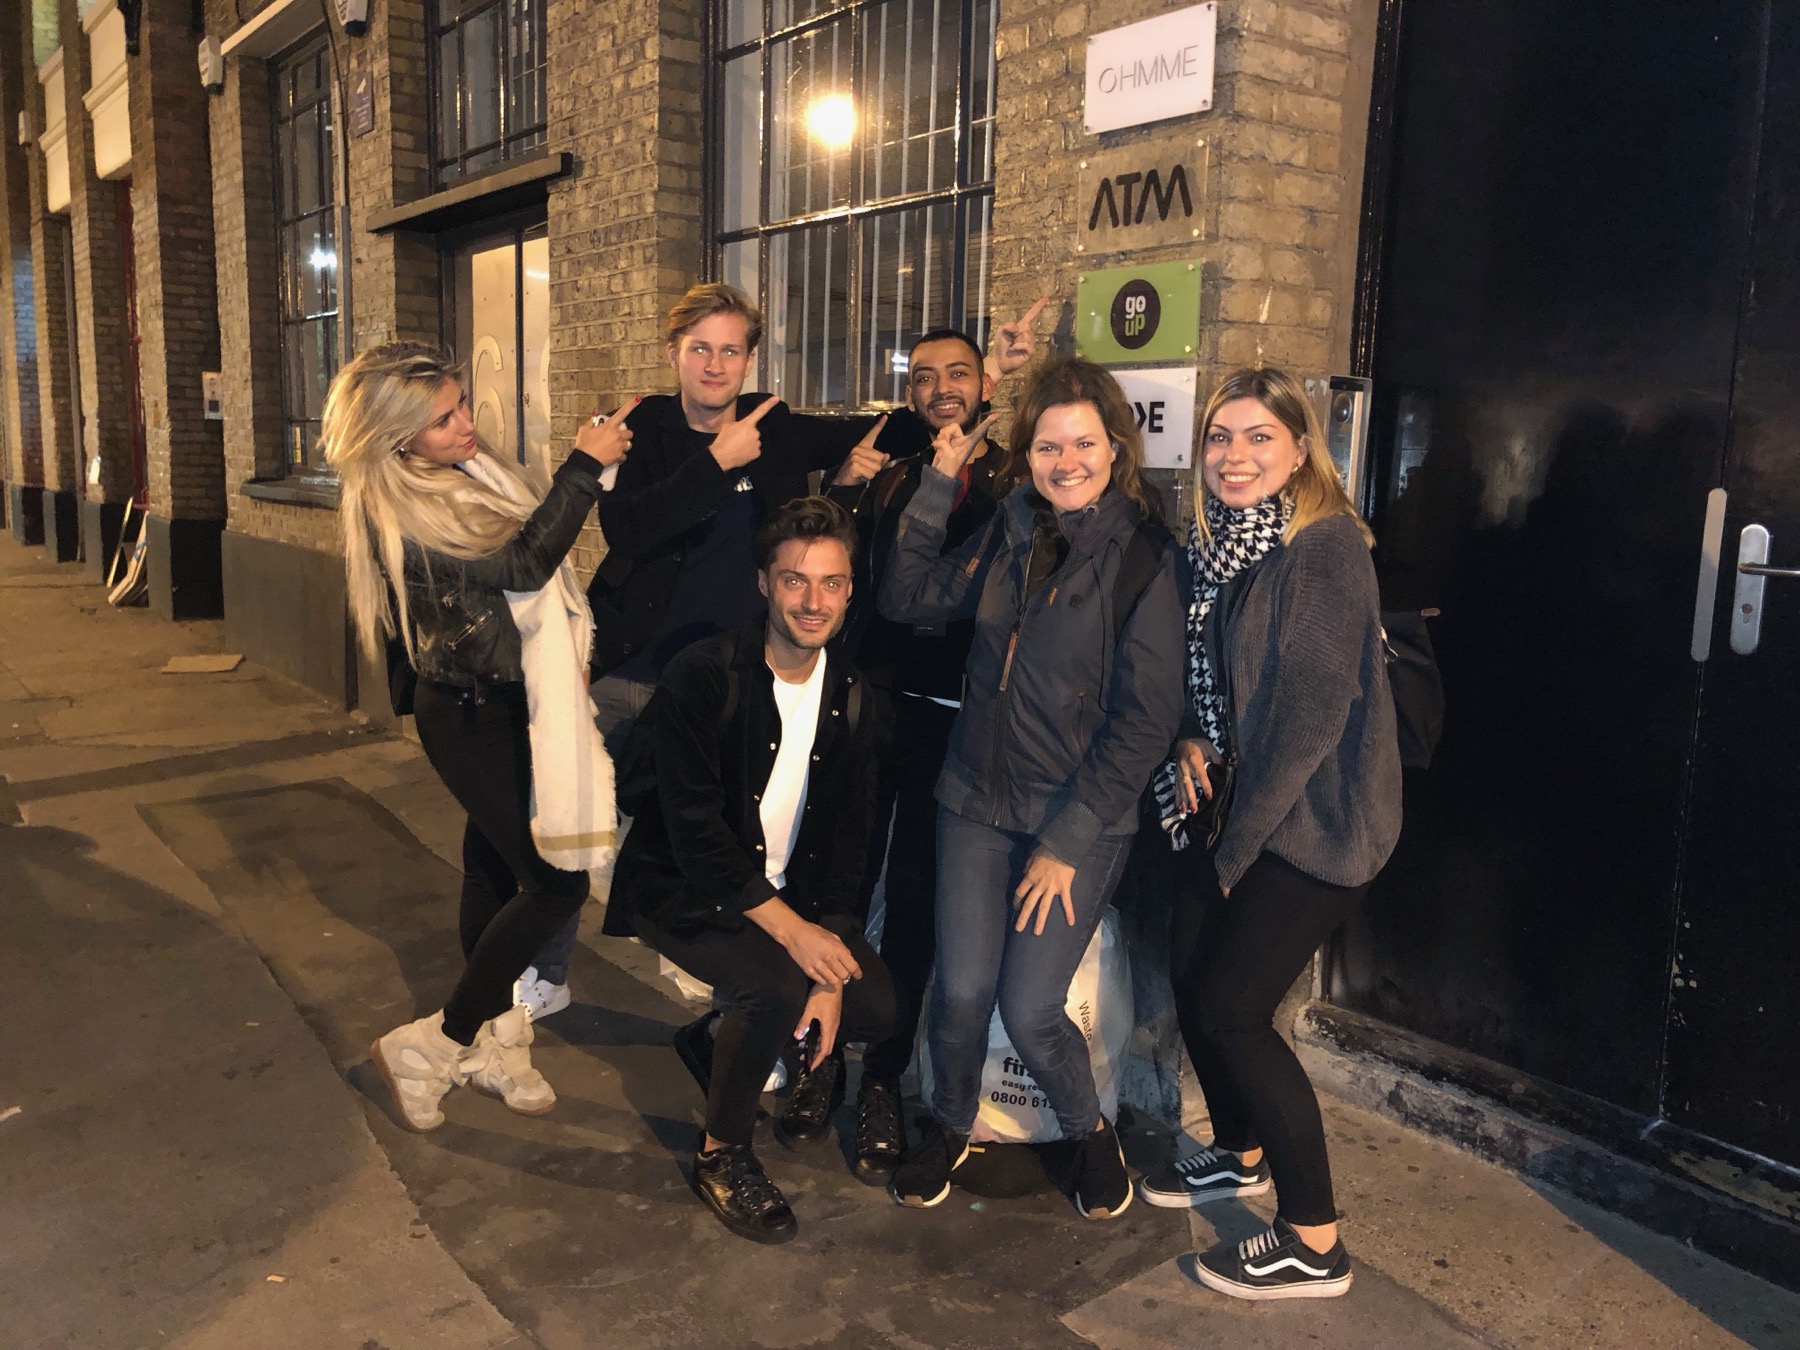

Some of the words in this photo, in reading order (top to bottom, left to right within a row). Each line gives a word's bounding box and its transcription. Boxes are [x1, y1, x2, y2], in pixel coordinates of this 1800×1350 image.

[1098, 45, 1199, 94] OHMME
[1088, 164, 1193, 231] ATM
[1125, 295, 1147, 319] go
[1124, 313, 1146, 337] up
[1079, 1000, 1093, 1041] Waste
[1003, 1056, 1031, 1077] fir
[1001, 1080, 1026, 1092] easy
[1028, 1083, 1044, 1092] re
[991, 1091, 1027, 1106] 0800
[1031, 1096, 1052, 1109] 61
